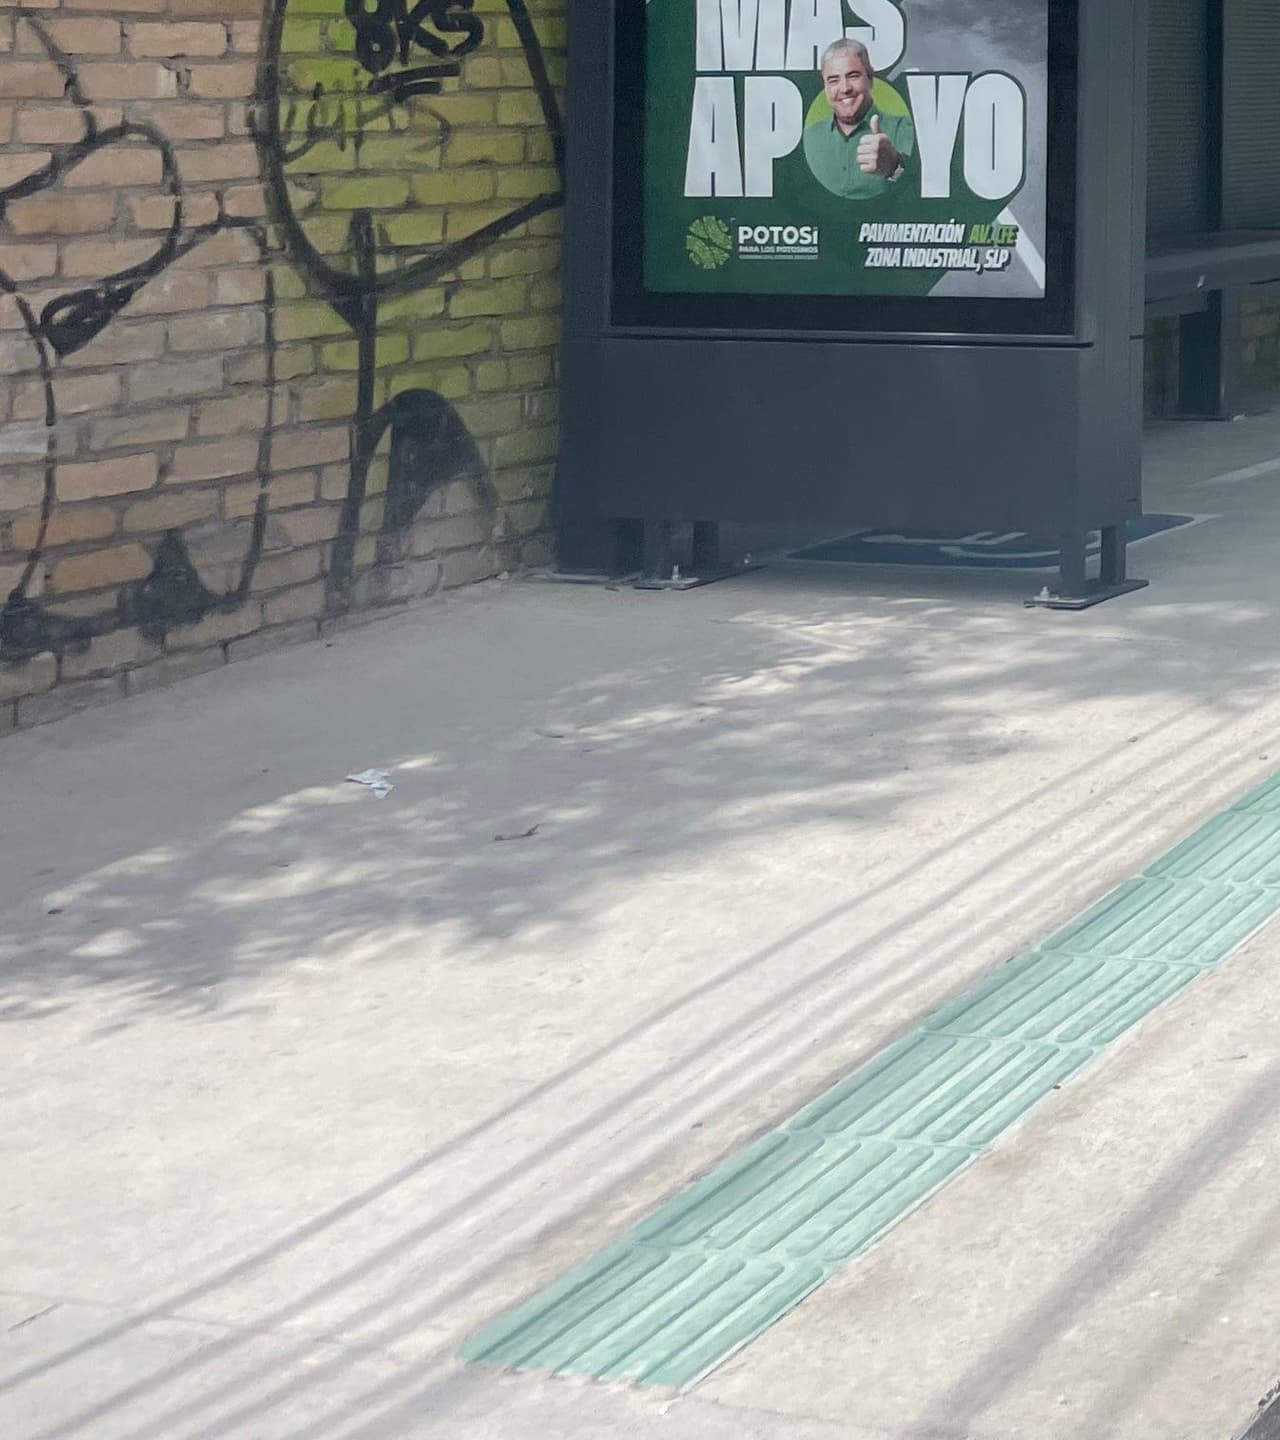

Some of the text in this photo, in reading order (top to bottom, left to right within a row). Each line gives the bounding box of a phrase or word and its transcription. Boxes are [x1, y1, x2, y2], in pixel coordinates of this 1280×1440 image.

[858, 218, 966, 243] PAVIMENTACIÓN
[864, 248, 1010, 271] ZONA INDUSTRIAL, SLP
